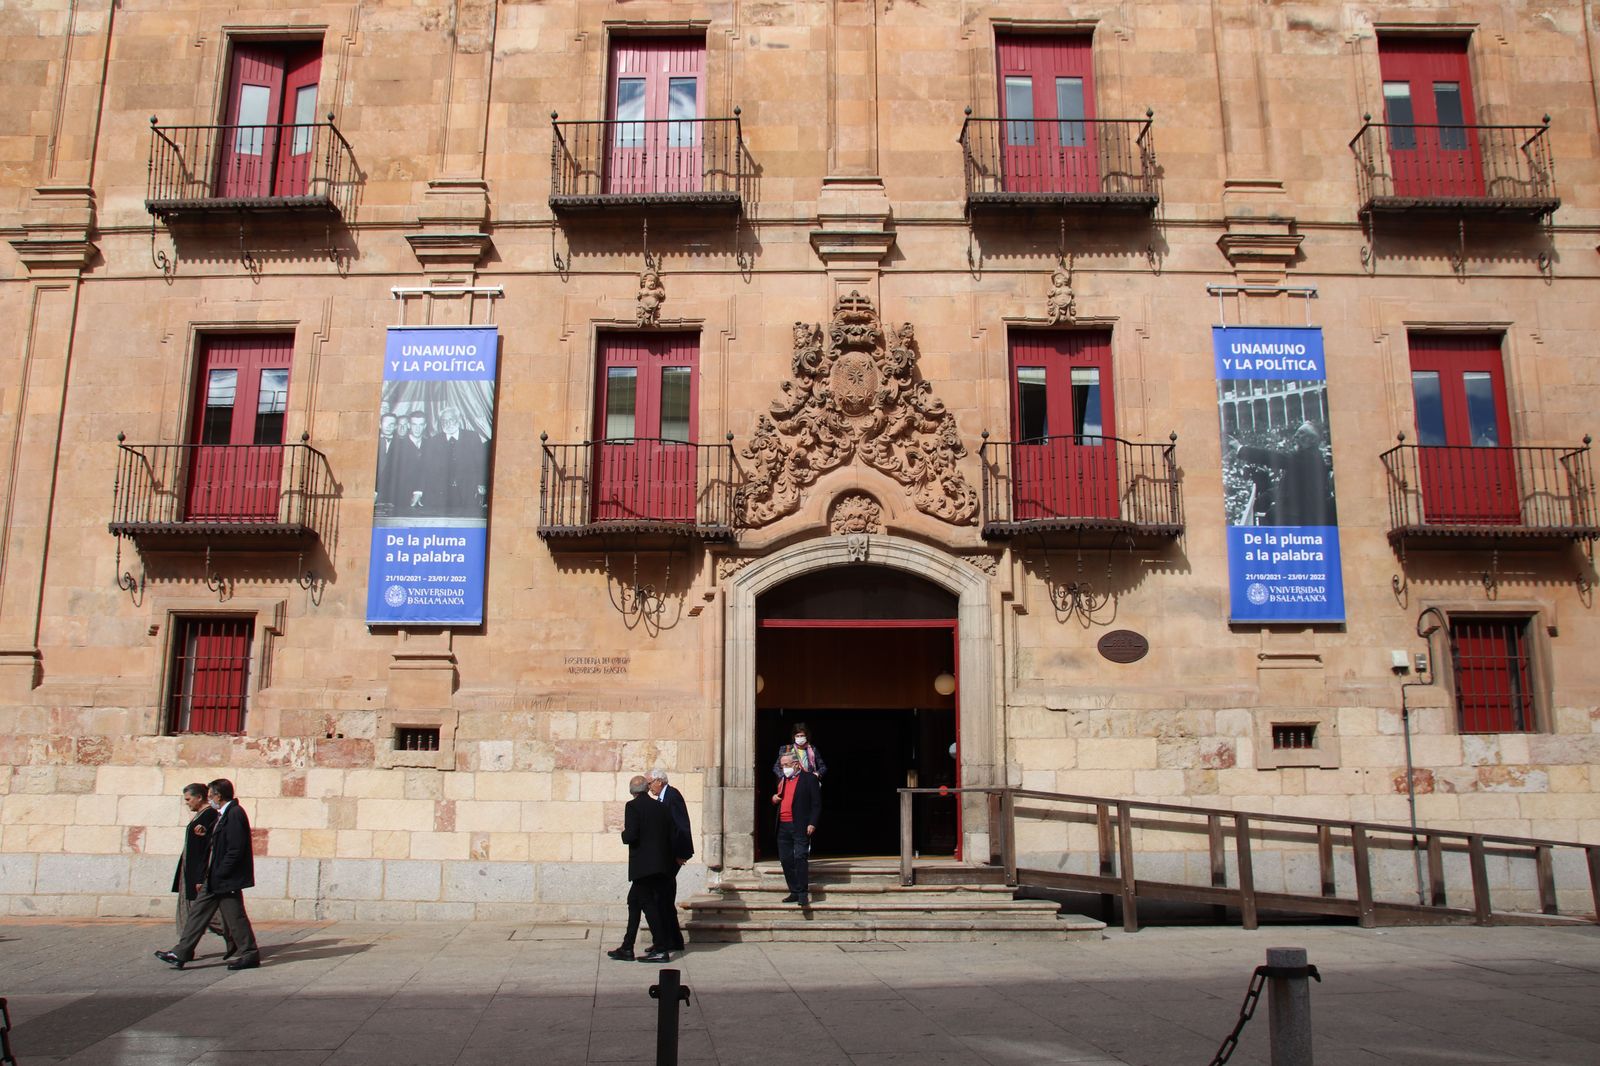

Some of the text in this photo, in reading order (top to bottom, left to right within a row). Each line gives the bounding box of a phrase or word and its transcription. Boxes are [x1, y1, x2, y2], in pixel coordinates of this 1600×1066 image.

[402, 345, 477, 356] UNAMUNO
[1231, 343, 1306, 355] UNAMUNO
[391, 358, 485, 372] Y LA POLÍTICA
[1222, 356, 1317, 371] Y LA POLÍTICA
[387, 534, 466, 549] De la pluma
[1244, 533, 1323, 548] De la pluma
[386, 550, 465, 565] a la palabra
[1245, 549, 1324, 564] a la palabra
[1309, 573, 1326, 581] 2022
